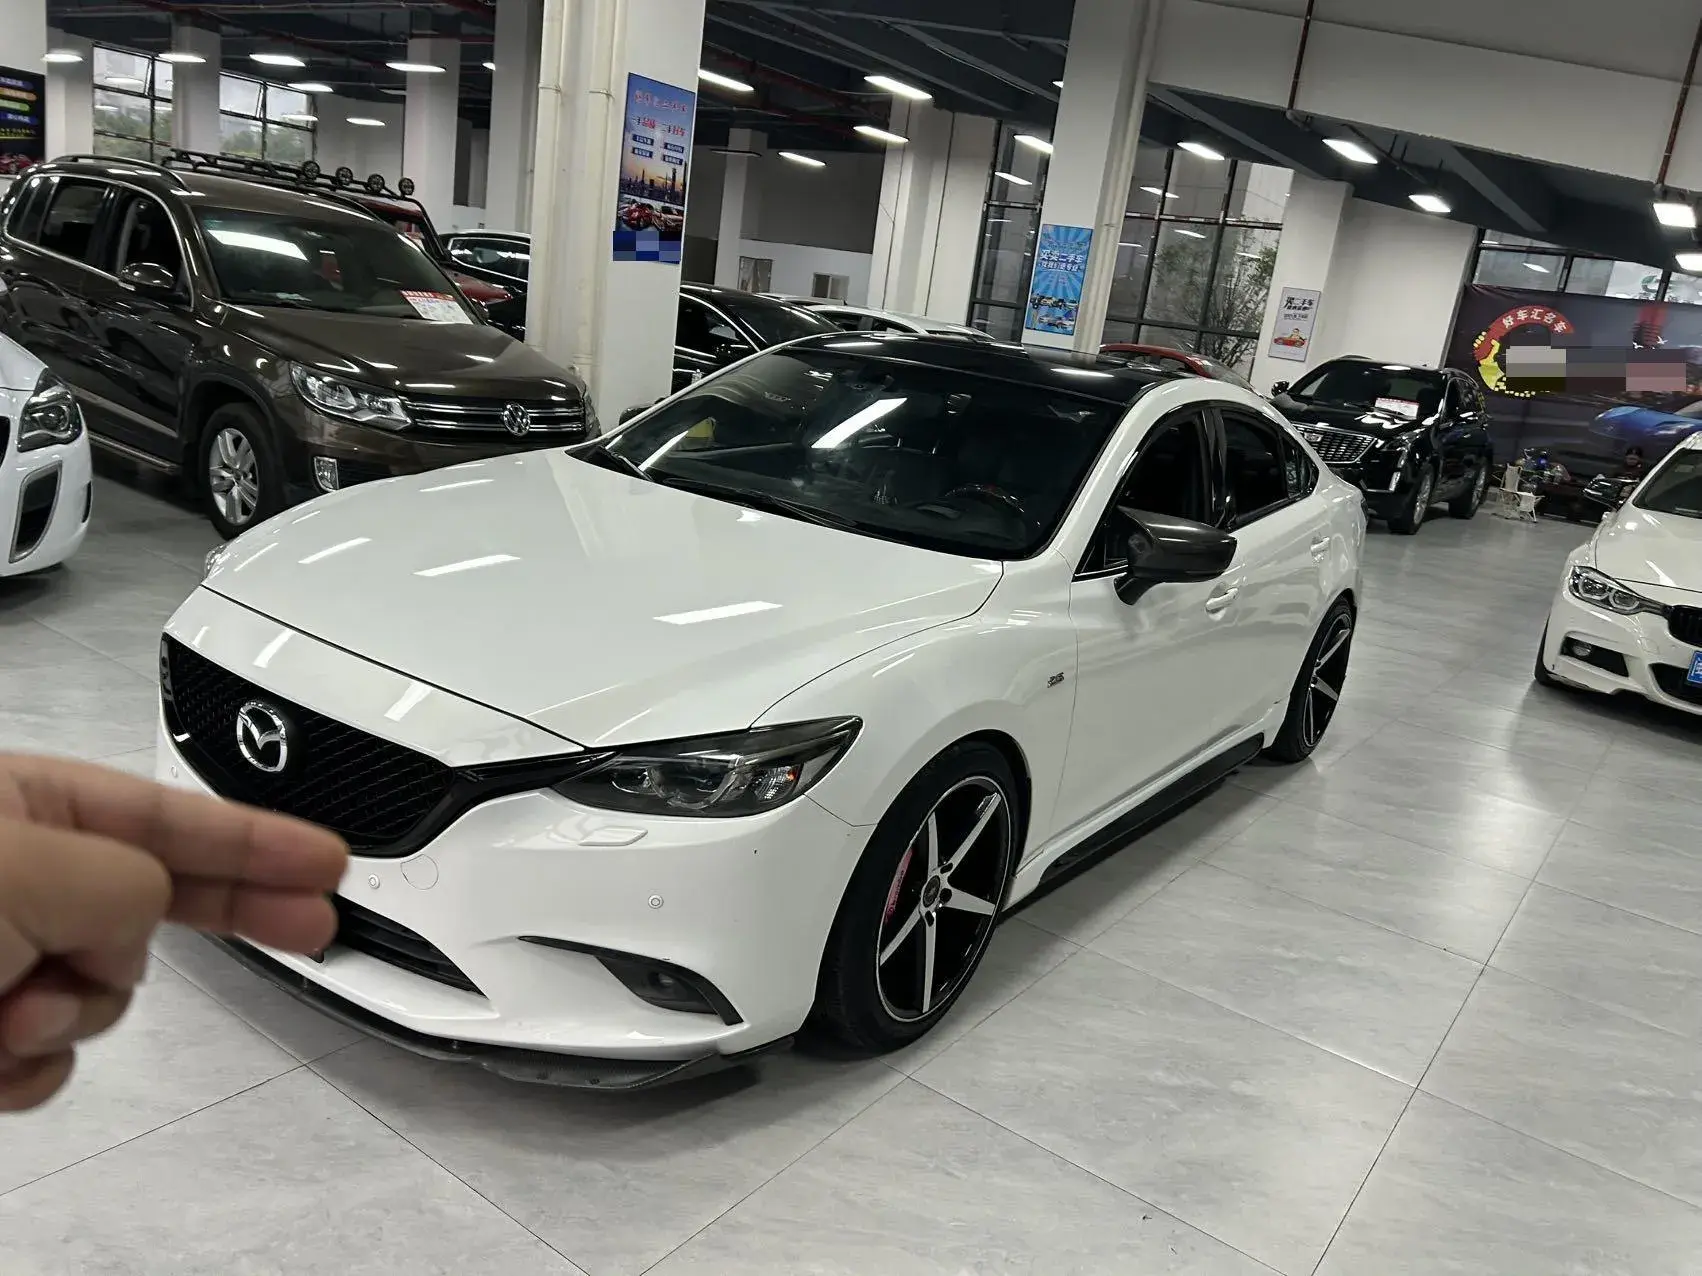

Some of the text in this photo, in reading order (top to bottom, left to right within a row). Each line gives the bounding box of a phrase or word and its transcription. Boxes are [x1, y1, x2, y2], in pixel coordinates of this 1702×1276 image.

[1502, 308, 1569, 334] 好车汇名车
